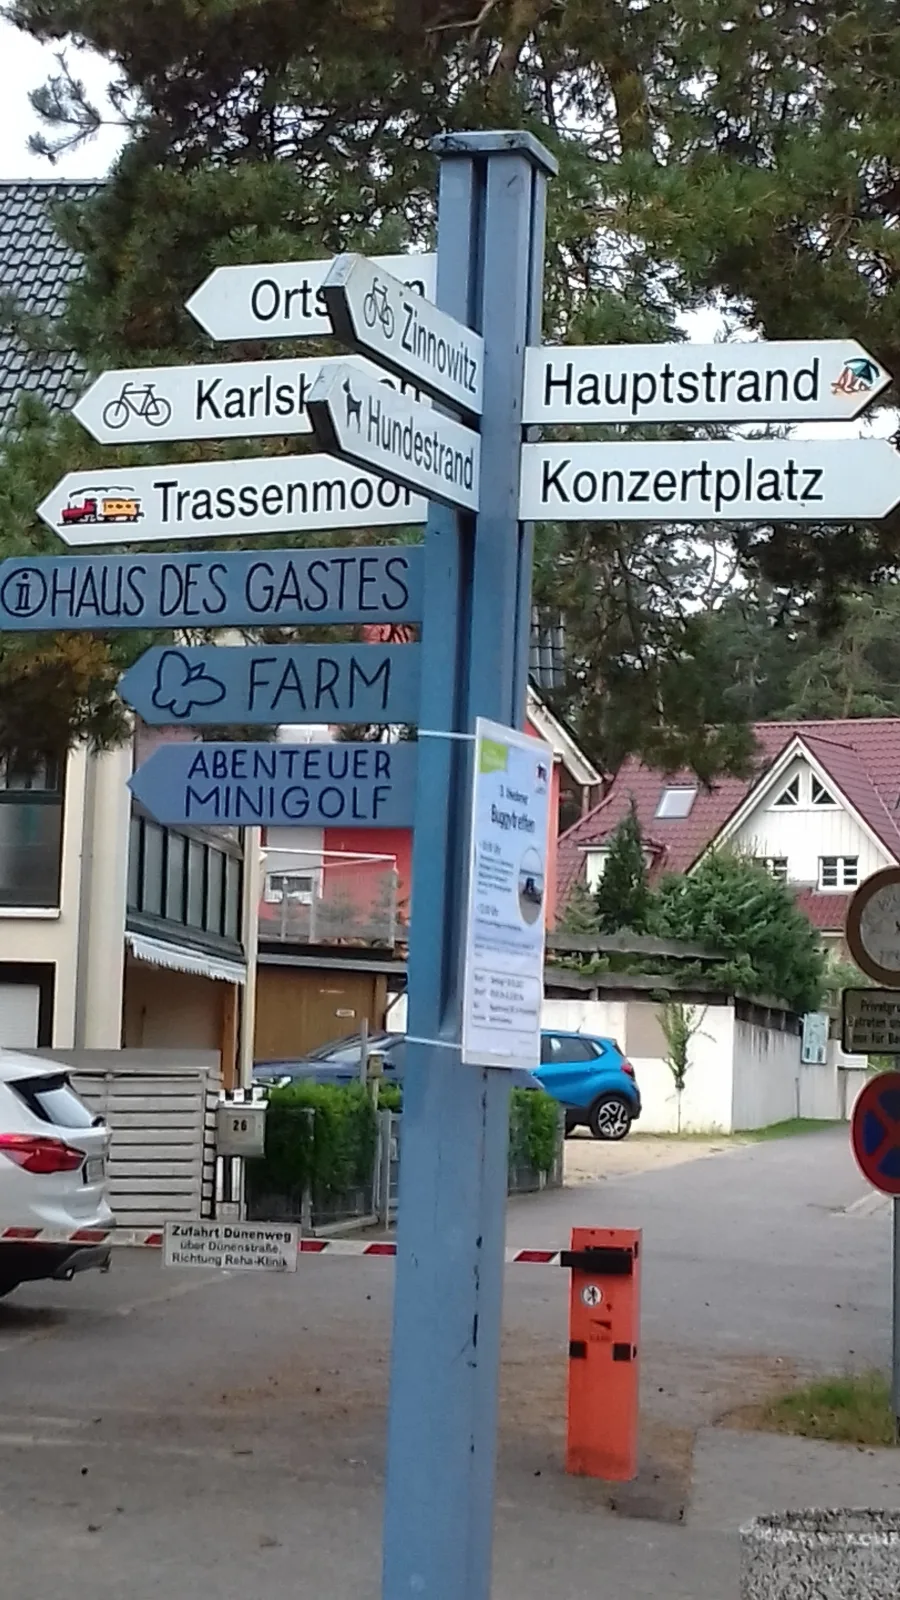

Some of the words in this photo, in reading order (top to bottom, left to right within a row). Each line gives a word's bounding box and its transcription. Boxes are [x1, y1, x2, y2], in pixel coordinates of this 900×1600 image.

[401, 302, 477, 394] Zinnowitz
[543, 357, 820, 415] Hauptstrand
[367, 395, 474, 491] Hundestrand
[541, 458, 824, 512] Konzertplatz
[52, 565, 147, 617] HAUS
[160, 563, 228, 616] DES
[246, 557, 409, 613] GASTES
[248, 657, 392, 711] FARM
[188, 749, 392, 780] ABENTEUER
[185, 785, 393, 820] MINIGOLF
[171, 1225, 220, 1239] Zufahrt
[224, 1226, 292, 1243] Dünenweg
[172, 1252, 222, 1267] Richtung
